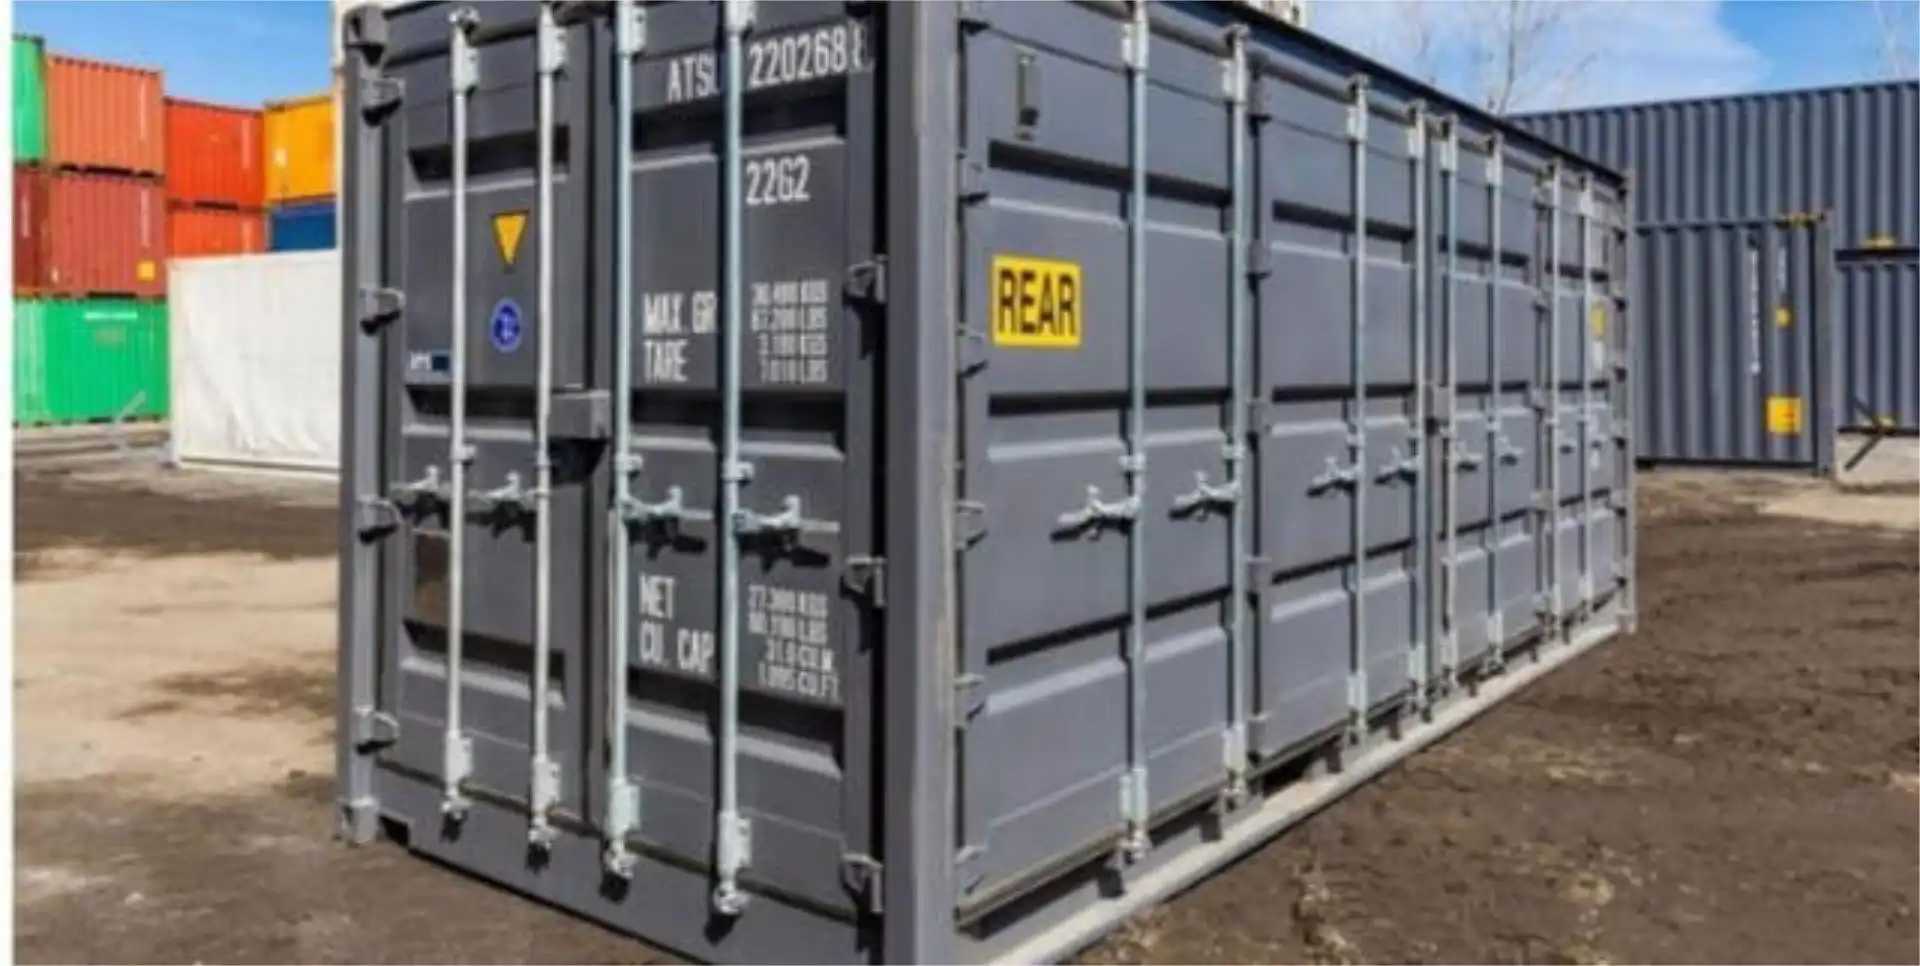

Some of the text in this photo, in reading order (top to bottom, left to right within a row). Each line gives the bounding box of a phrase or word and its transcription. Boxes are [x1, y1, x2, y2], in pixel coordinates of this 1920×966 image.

[748, 27, 848, 88] 220268
[998, 269, 1076, 337] REAR
[643, 339, 689, 383] TARE
[639, 572, 676, 620] NET
[678, 628, 714, 674] CAP
